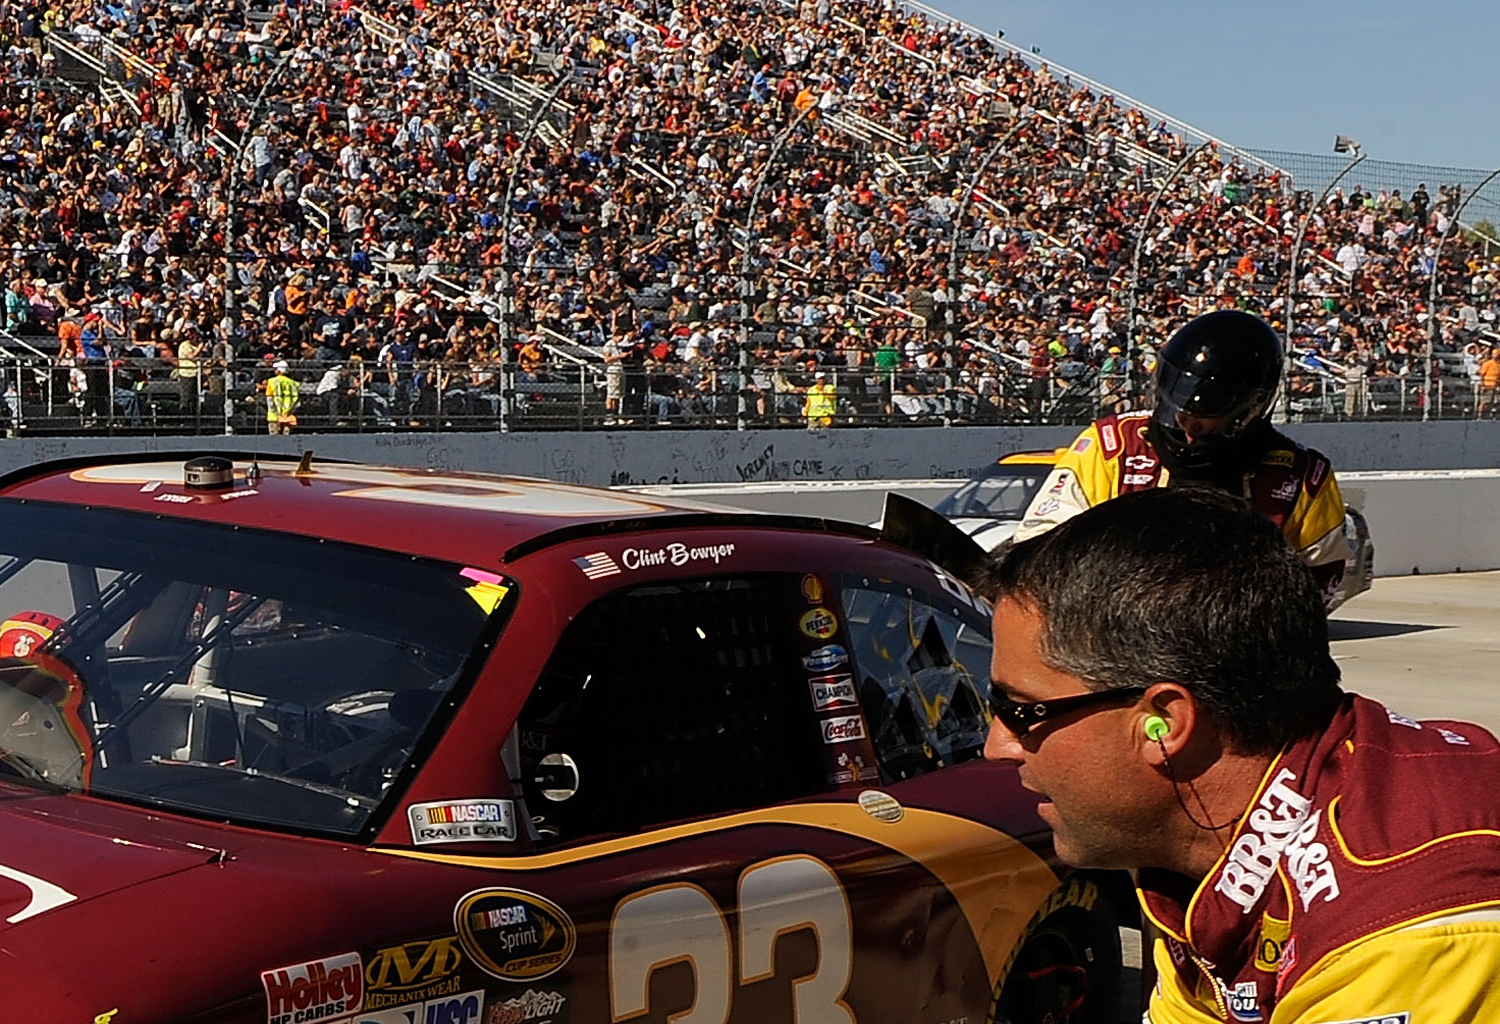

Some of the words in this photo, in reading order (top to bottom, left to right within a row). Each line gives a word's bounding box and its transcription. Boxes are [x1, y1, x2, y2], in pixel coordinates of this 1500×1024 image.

[622, 547, 668, 569] Clint
[666, 543, 735, 566] Bowyer
[451, 804, 500, 823] NASCAR
[420, 826, 472, 839] RACE
[473, 825, 508, 838] CAR
[1214, 767, 1314, 914] BB&T
[488, 905, 528, 929] NASCAR
[500, 925, 539, 953] Sprint
[264, 962, 362, 1015] Holley
[363, 989, 426, 1011] MECHANIX
[427, 976, 461, 996] WEAR
[294, 1000, 346, 1024] CARBS
[524, 997, 567, 1021] LIGHT
